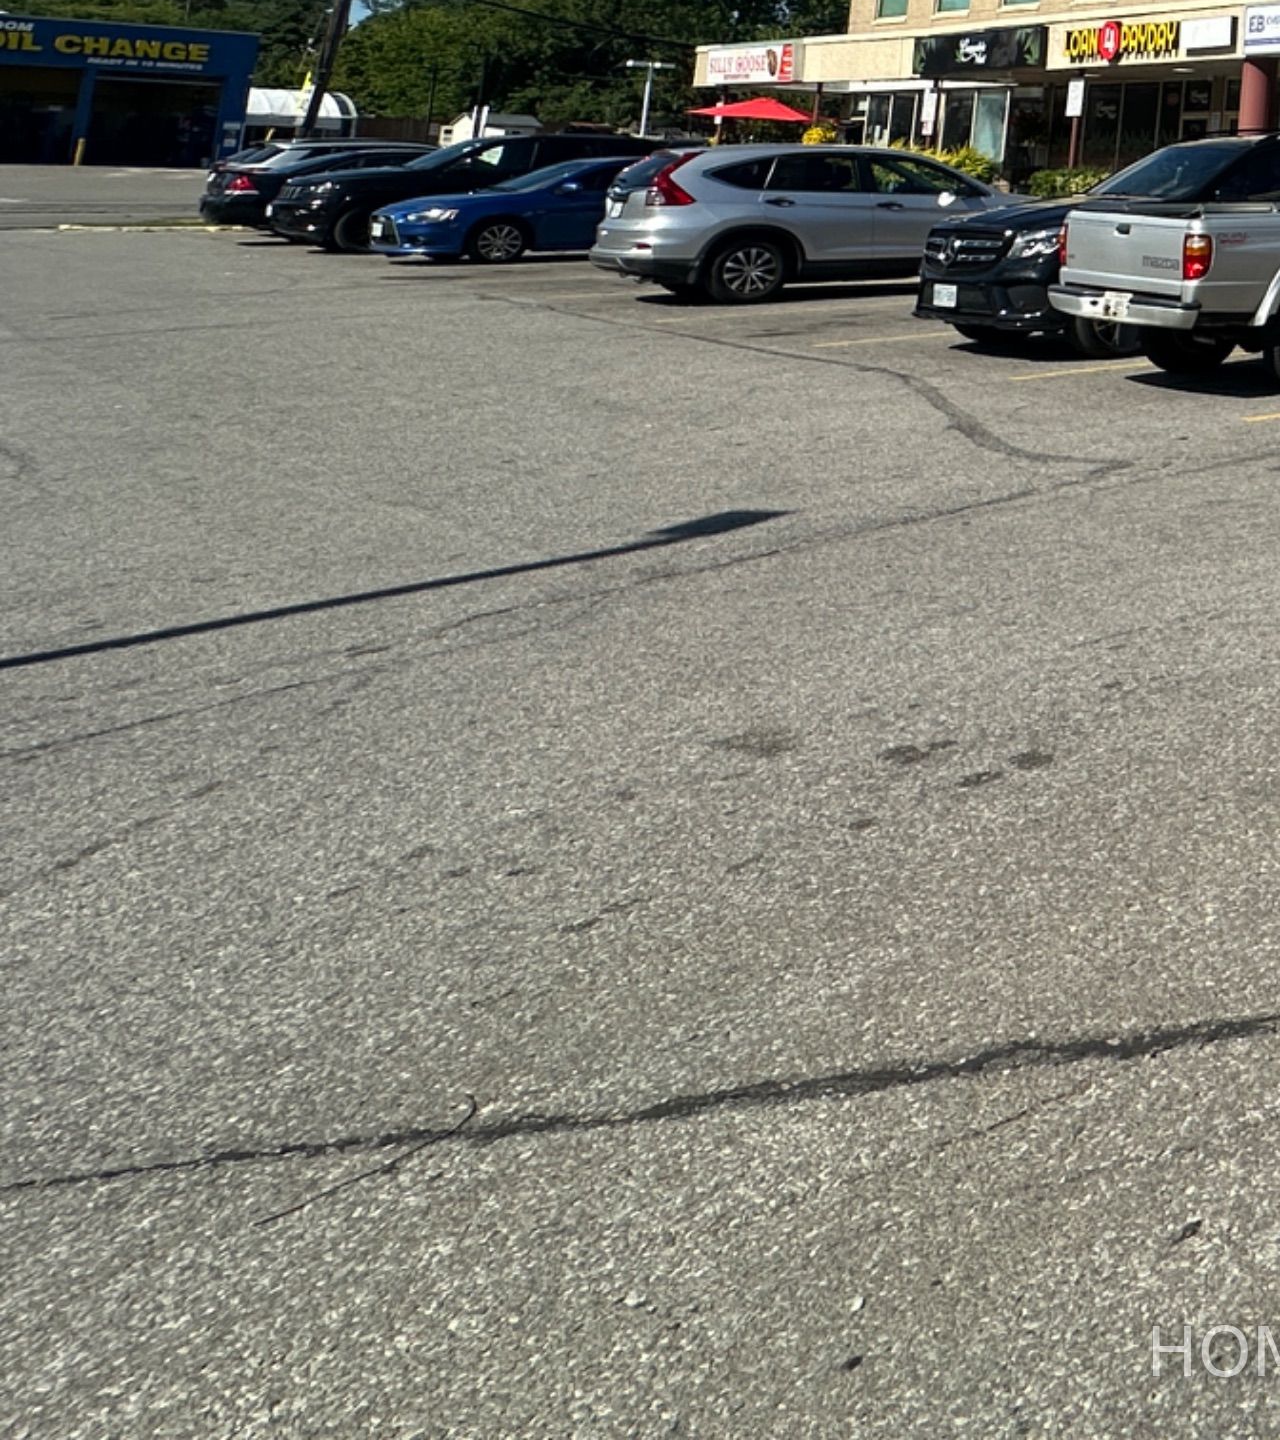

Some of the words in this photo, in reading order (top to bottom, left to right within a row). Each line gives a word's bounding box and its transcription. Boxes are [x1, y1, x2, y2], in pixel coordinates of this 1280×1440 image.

[54, 34, 210, 62] CHANGE
[1064, 28, 1100, 57] LOAN
[1103, 27, 1115, 55] 4
[1121, 21, 1177, 51] PAYDAY
